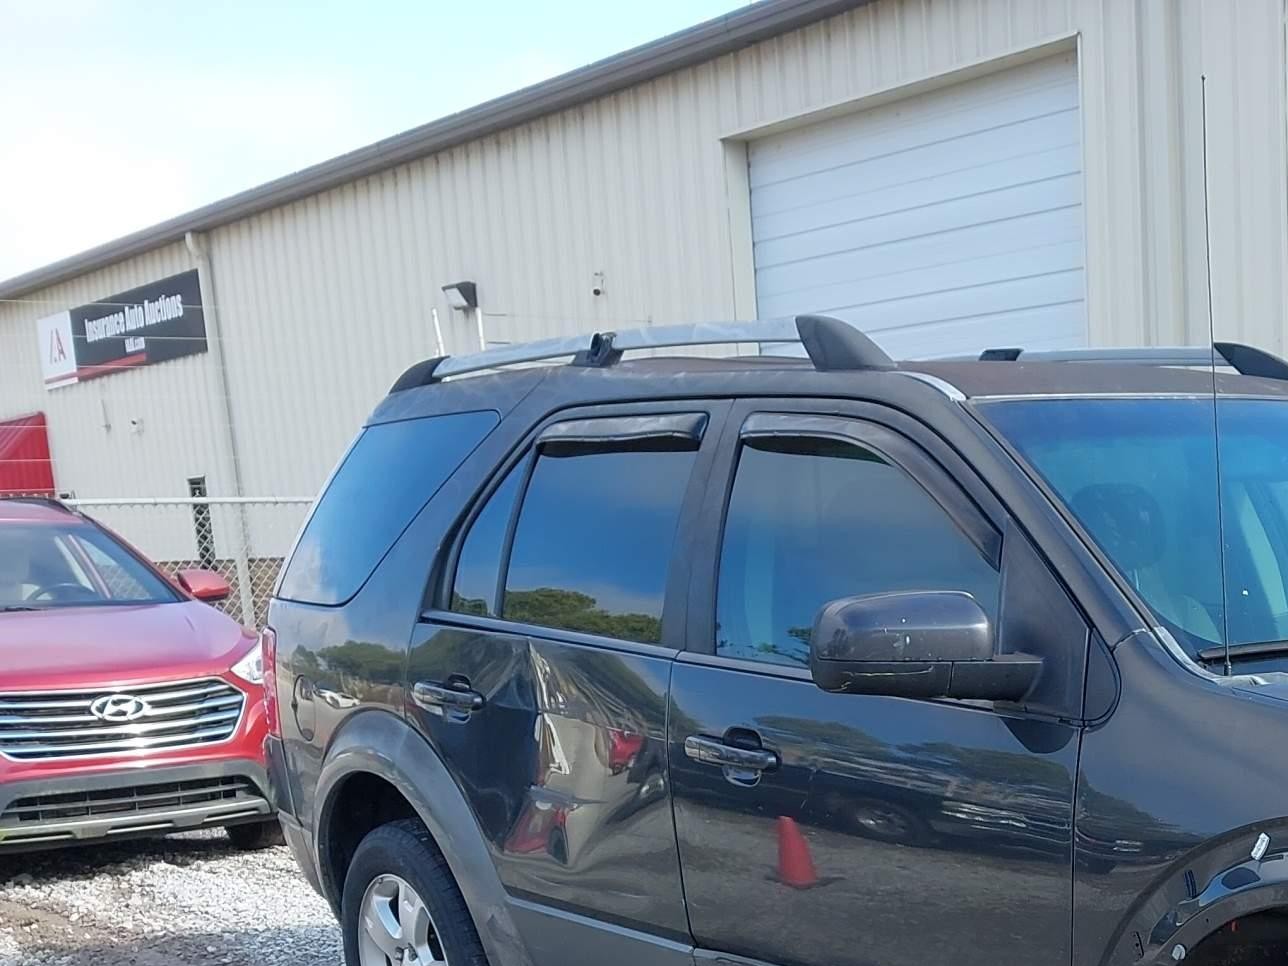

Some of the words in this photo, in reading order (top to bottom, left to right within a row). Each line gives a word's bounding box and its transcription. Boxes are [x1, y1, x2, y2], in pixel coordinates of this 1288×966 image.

[84, 311, 125, 342] Insurance
[124, 304, 144, 331] Auto
[144, 294, 184, 326] Auctions
